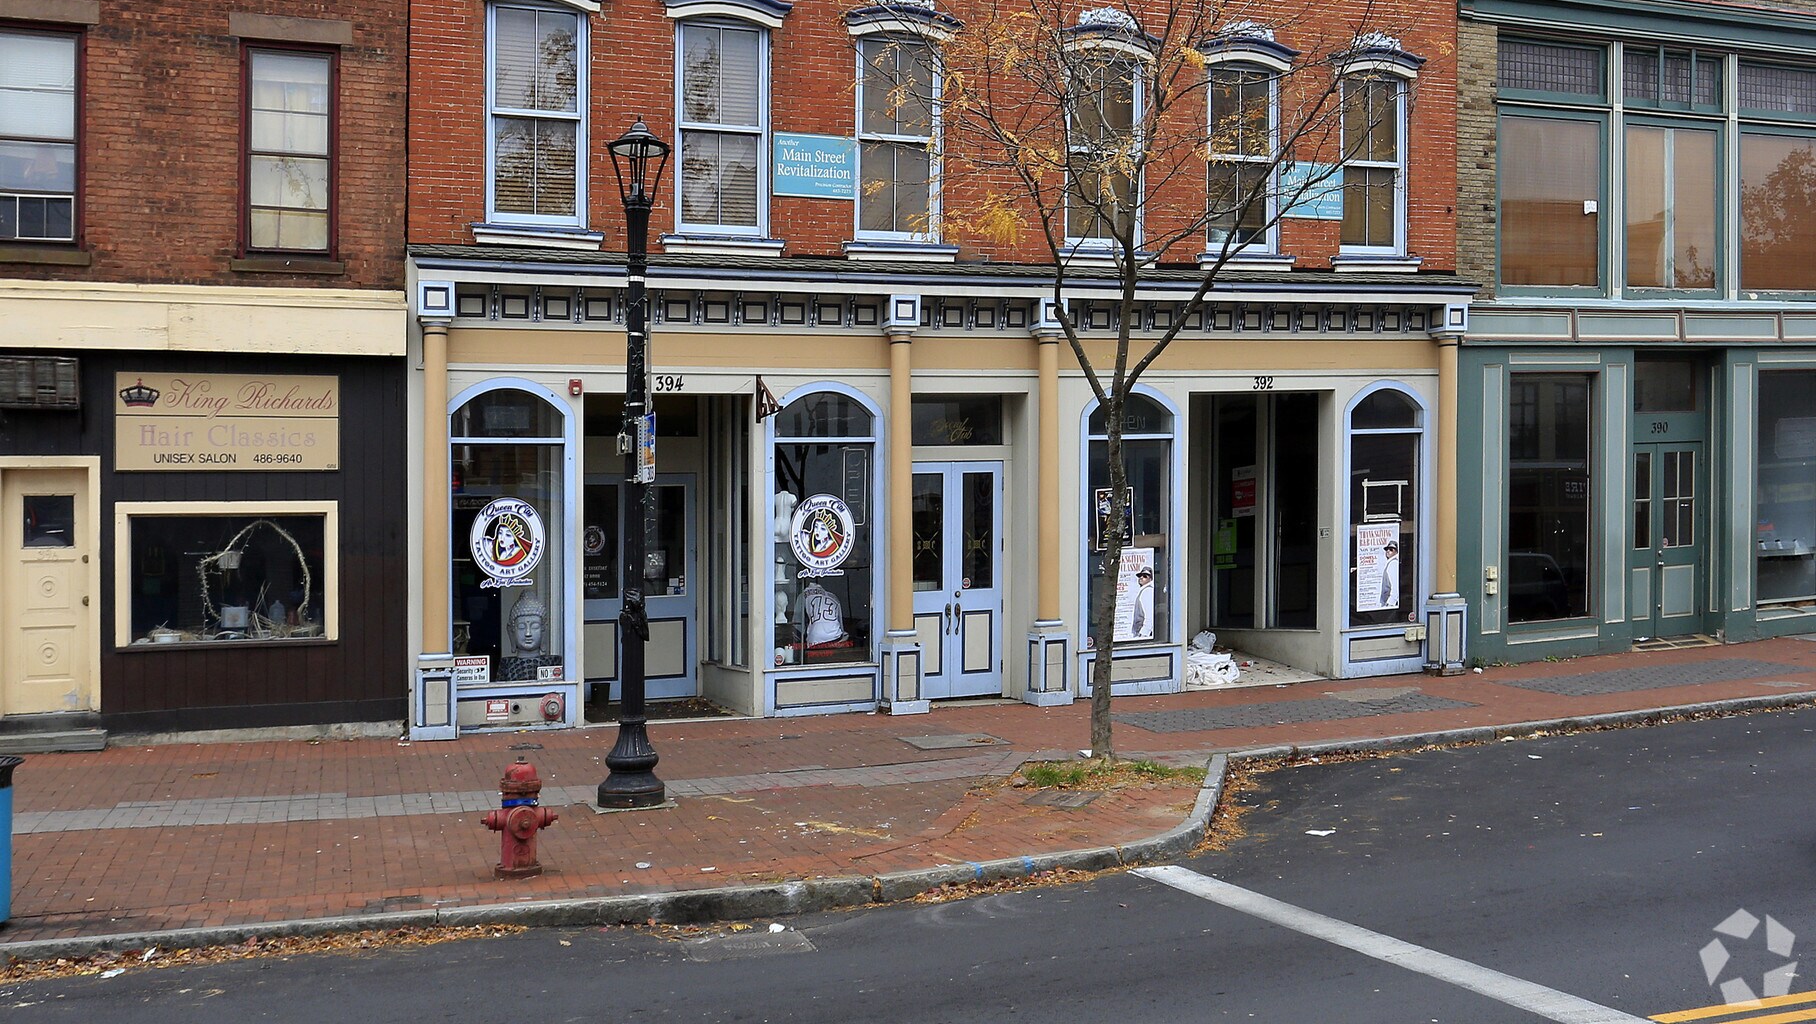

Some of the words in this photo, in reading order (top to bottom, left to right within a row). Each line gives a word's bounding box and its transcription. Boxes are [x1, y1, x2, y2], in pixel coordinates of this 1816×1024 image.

[782, 148, 811, 162] Main
[815, 150, 845, 164] Street
[777, 163, 850, 179] Revitalization
[655, 374, 684, 392] 394
[1252, 376, 1274, 389] 392
[163, 379, 231, 420] King
[235, 380, 336, 410] Richards
[139, 424, 193, 447] Hair
[207, 424, 316, 447] Classics
[1651, 421, 1668, 434] 390
[153, 453, 195, 464] UNISEX
[198, 453, 237, 464] SALON
[253, 453, 302, 464] 486-9640
[481, 503, 513, 521] Queen
[800, 499, 828, 516] Queen
[475, 539, 496, 571] TATTOO
[518, 537, 541, 571] GALLERY
[794, 533, 812, 562] TATTOO
[831, 531, 851, 562] GALLERY
[811, 596, 838, 624] 13
[456, 658, 486, 666] WARNING
[540, 669, 549, 679] NO
